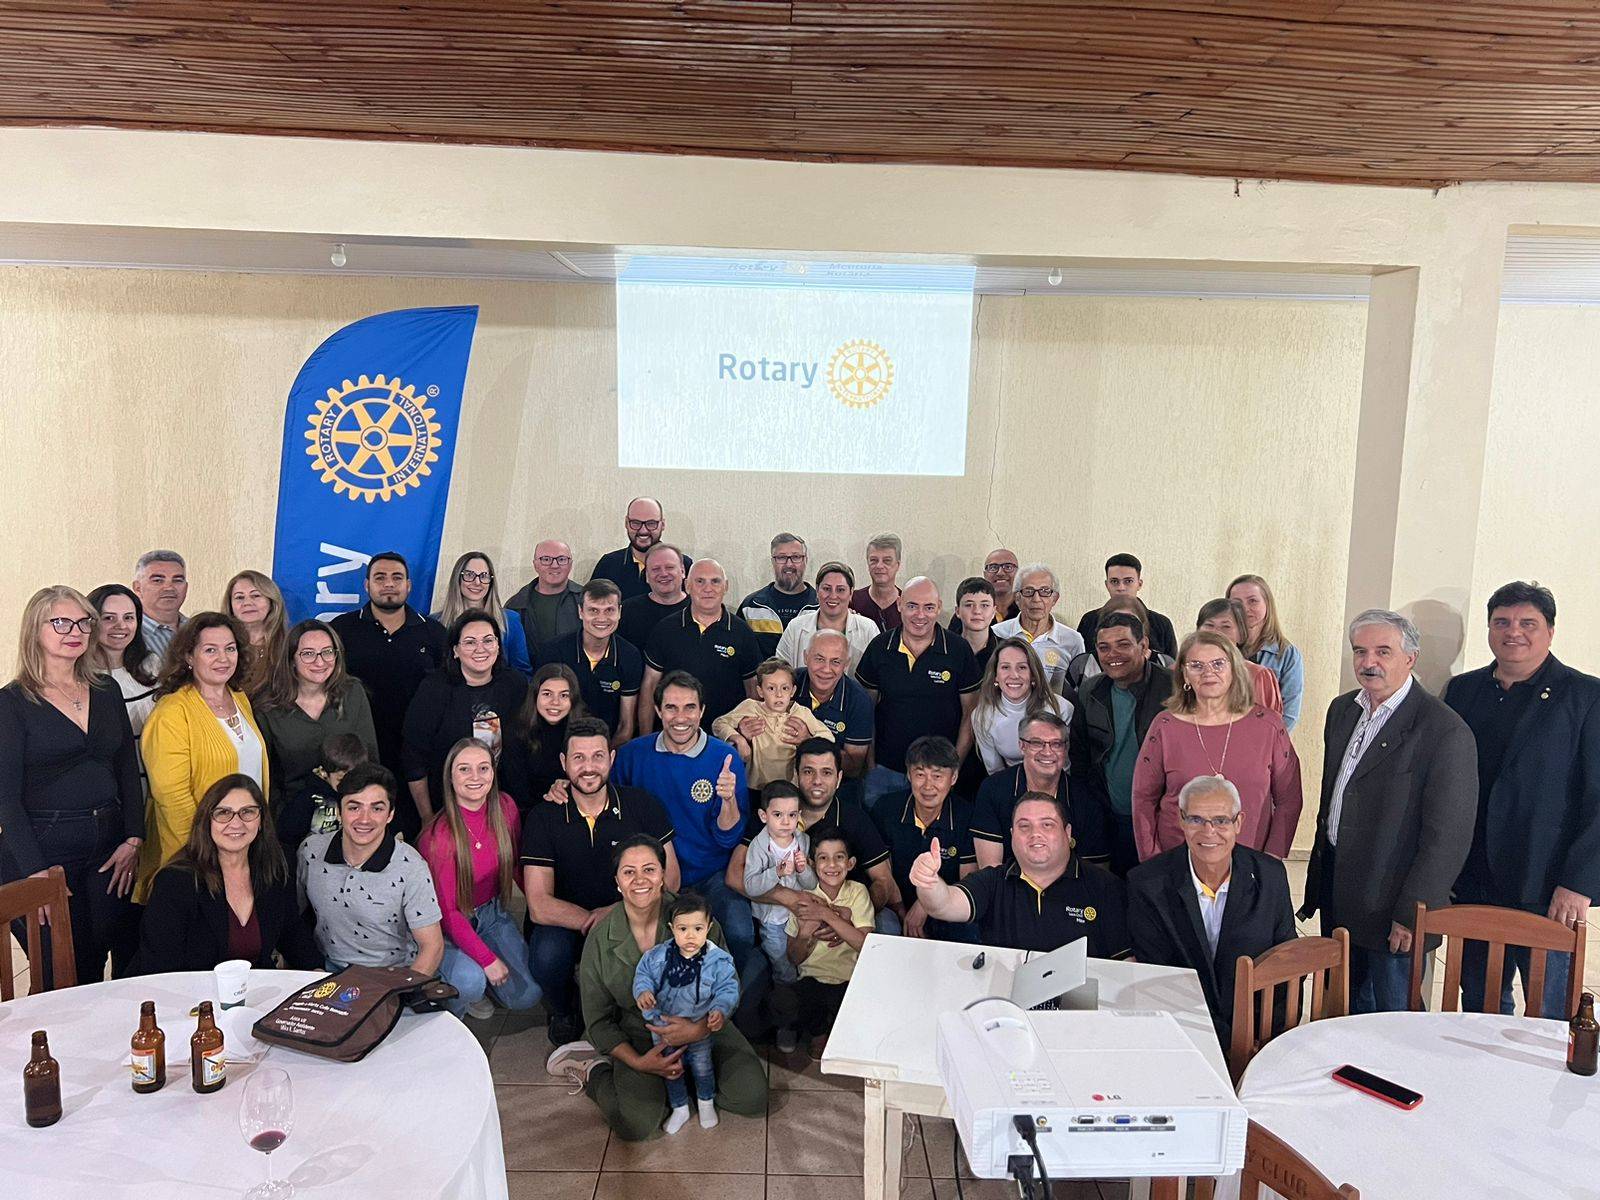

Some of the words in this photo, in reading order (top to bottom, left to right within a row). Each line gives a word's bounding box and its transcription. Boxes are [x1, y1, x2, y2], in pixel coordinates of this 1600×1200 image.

[718, 353, 818, 388] Rotary
[320, 409, 337, 463] ROTARY
[393, 395, 428, 484] INTERNATIONAL
